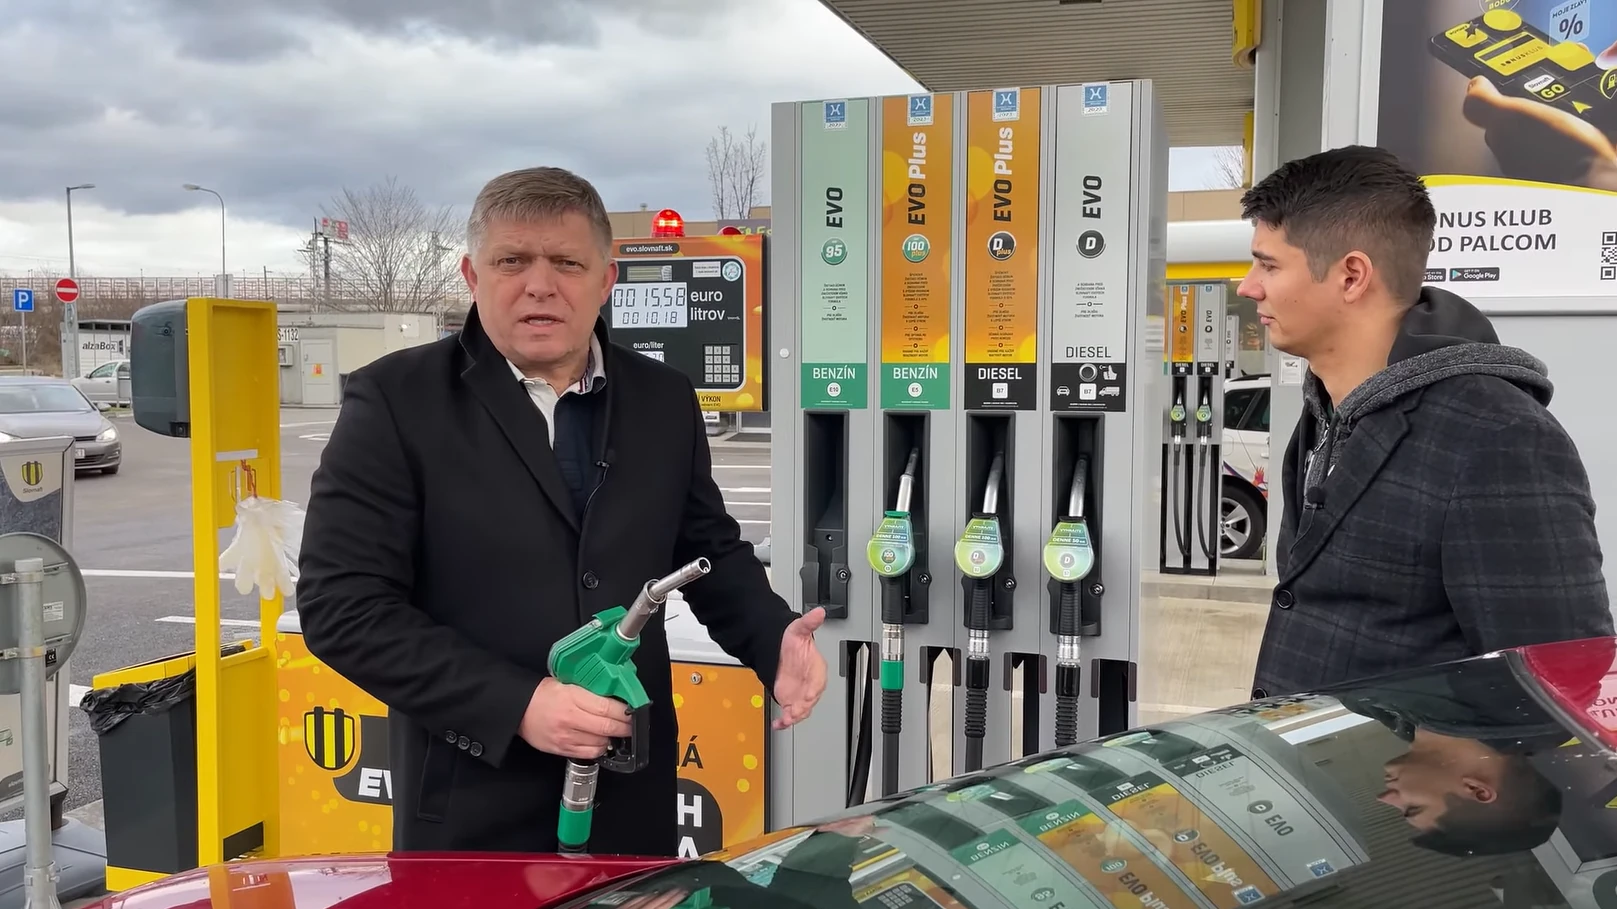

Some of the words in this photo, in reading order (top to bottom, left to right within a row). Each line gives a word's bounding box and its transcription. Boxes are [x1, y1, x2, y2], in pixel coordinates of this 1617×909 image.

[1552, 5, 1570, 19] MOJE
[1540, 84, 1565, 99] GO
[908, 132, 927, 179] Plus
[994, 127, 1014, 175] Plus
[908, 183, 926, 225] EVO
[993, 179, 1012, 222] EVO
[1082, 175, 1103, 219] EVO
[826, 186, 843, 228] EVO
[1493, 209, 1552, 227] KLUB
[907, 241, 925, 251] 100
[993, 238, 1003, 250] D
[1085, 237, 1097, 250] D
[1460, 234, 1556, 252] PALCOM
[826, 245, 842, 258] 95
[18, 291, 29, 308] P
[690, 290, 723, 302] euro
[690, 307, 726, 321] litrov
[82, 341, 116, 350] alzaBox
[633, 341, 665, 350] euro/liter
[1066, 346, 1112, 358] DIESEL
[812, 365, 856, 379] BENZÍN
[893, 365, 938, 379] BENZÍN
[978, 367, 1022, 380] DIESEL
